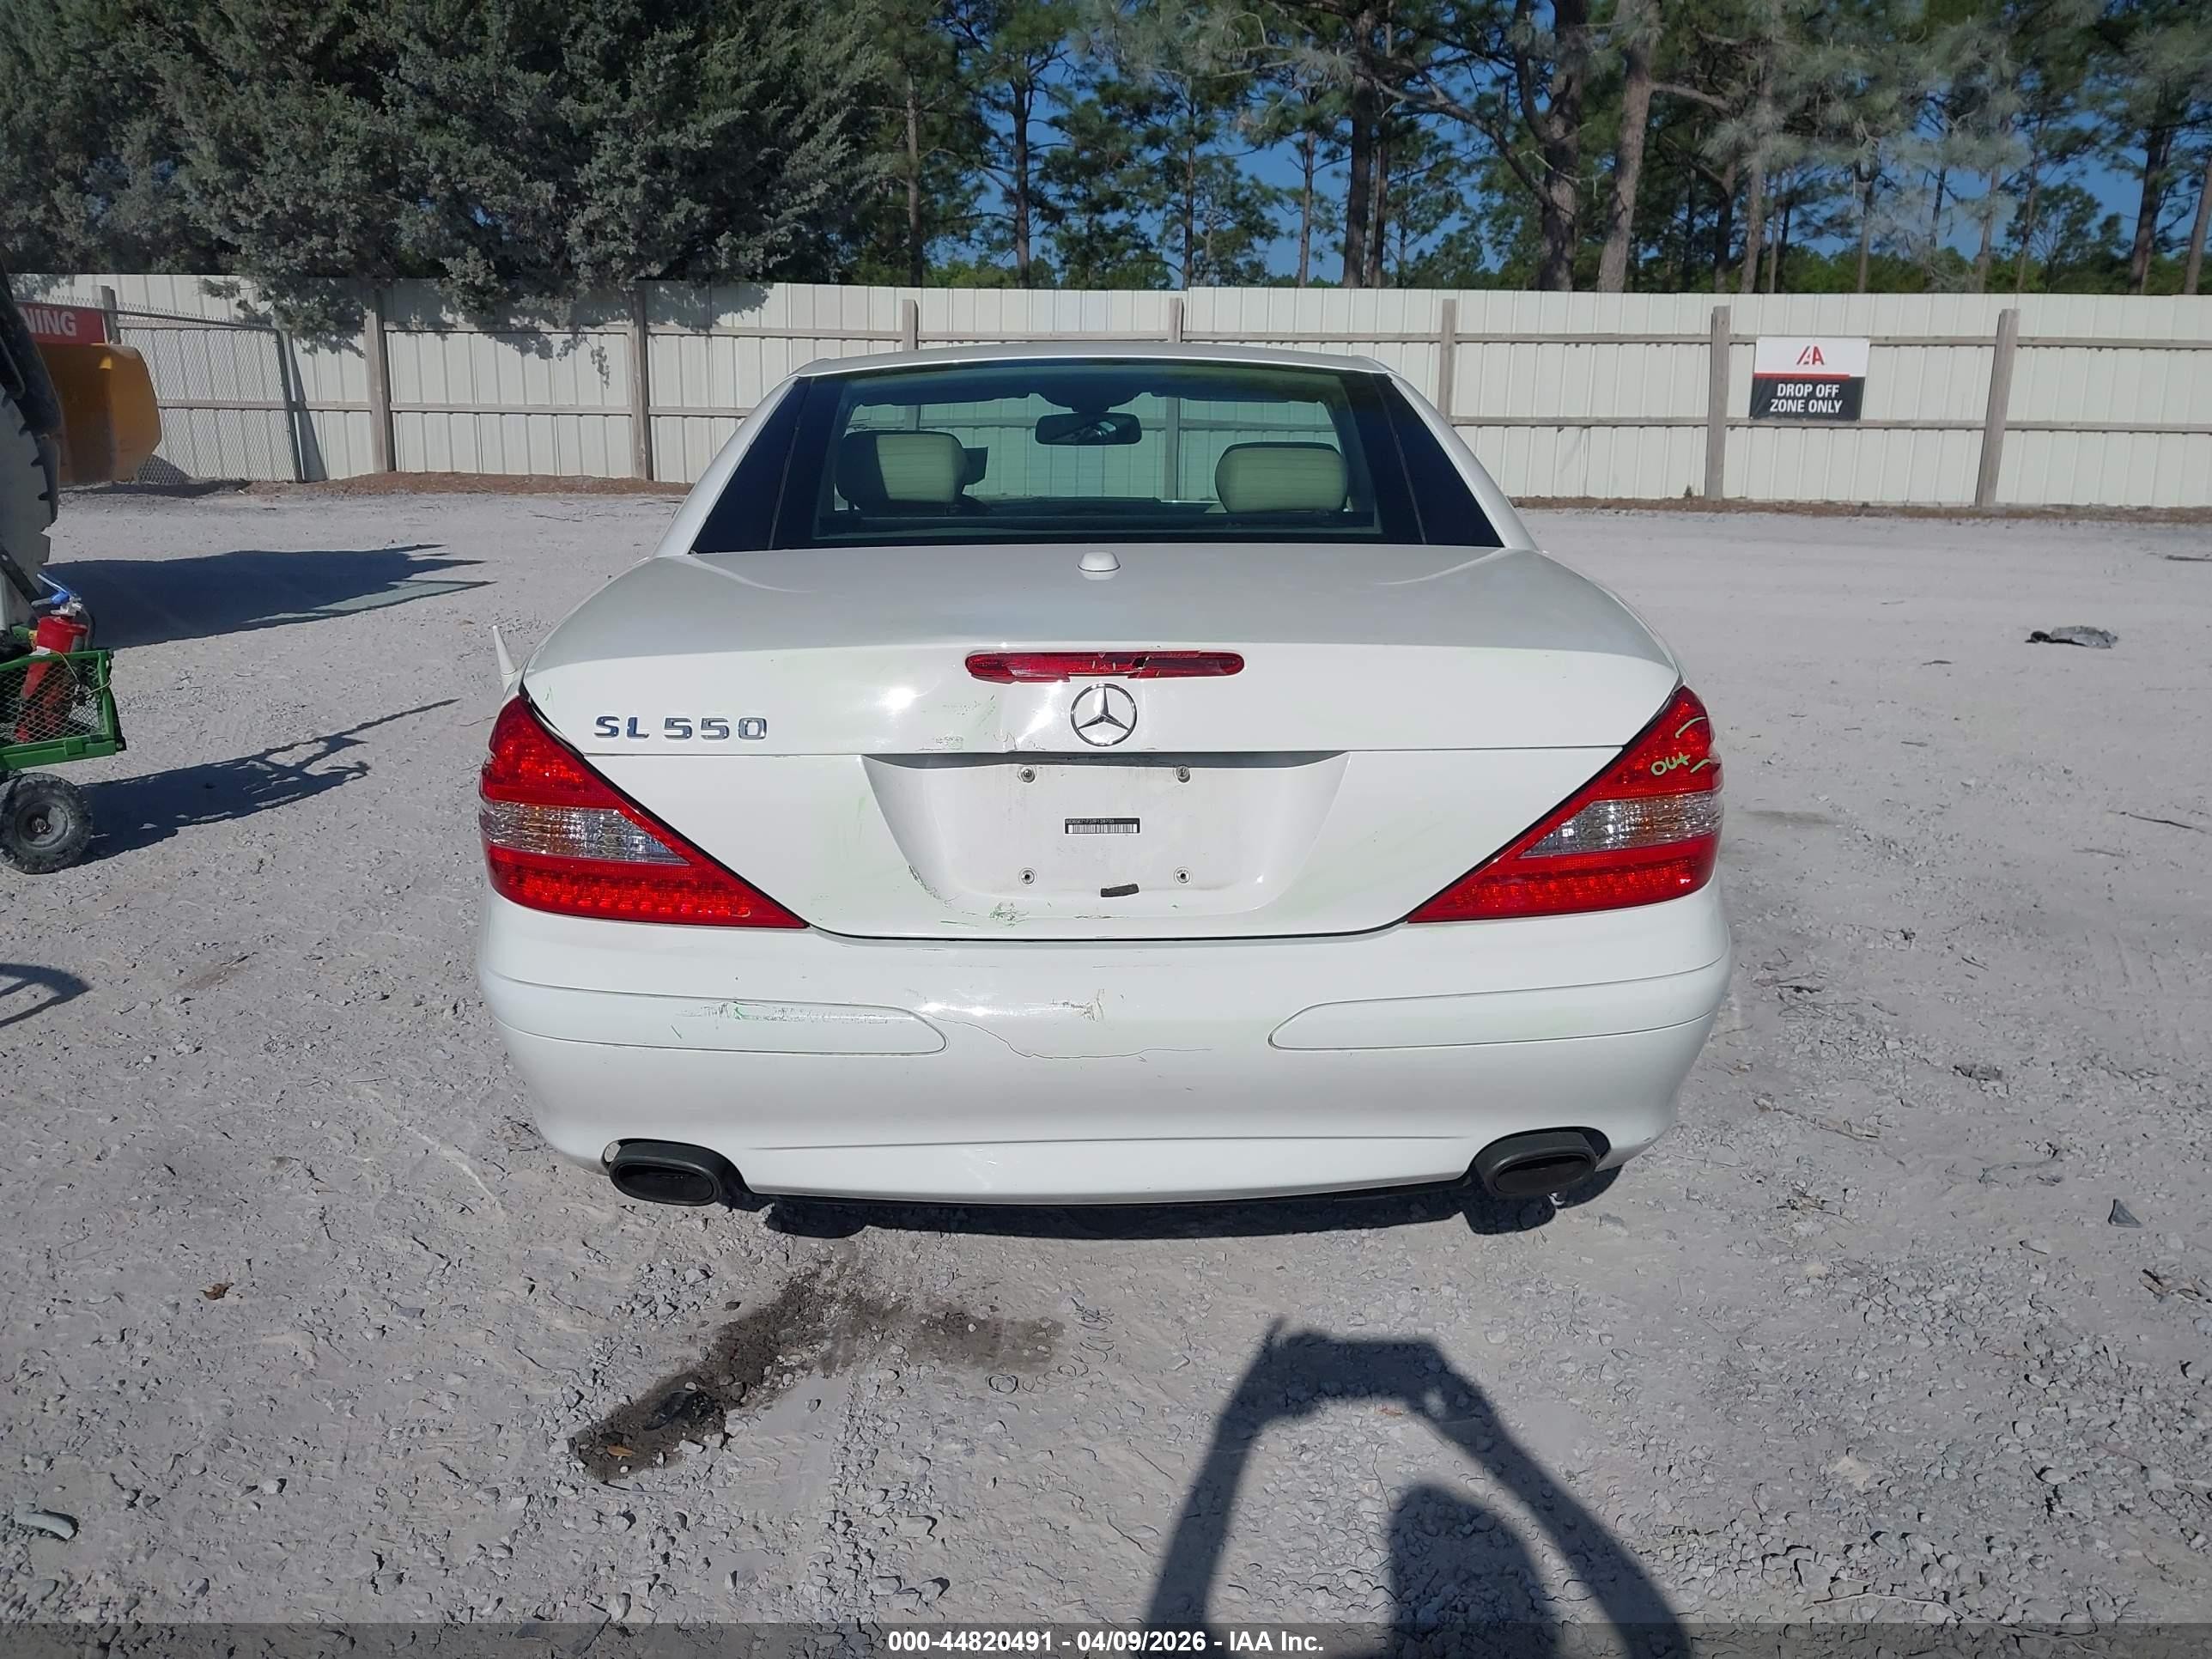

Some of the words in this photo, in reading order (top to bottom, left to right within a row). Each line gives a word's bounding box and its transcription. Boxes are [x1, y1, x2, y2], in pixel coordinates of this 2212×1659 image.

[1777, 383, 1813, 398] DROP
[1815, 384, 1840, 398] OFF
[1770, 398, 1805, 413] ZONE
[1808, 399, 1843, 414] ONLY
[593, 716, 650, 739] SL
[664, 717, 768, 740] 550
